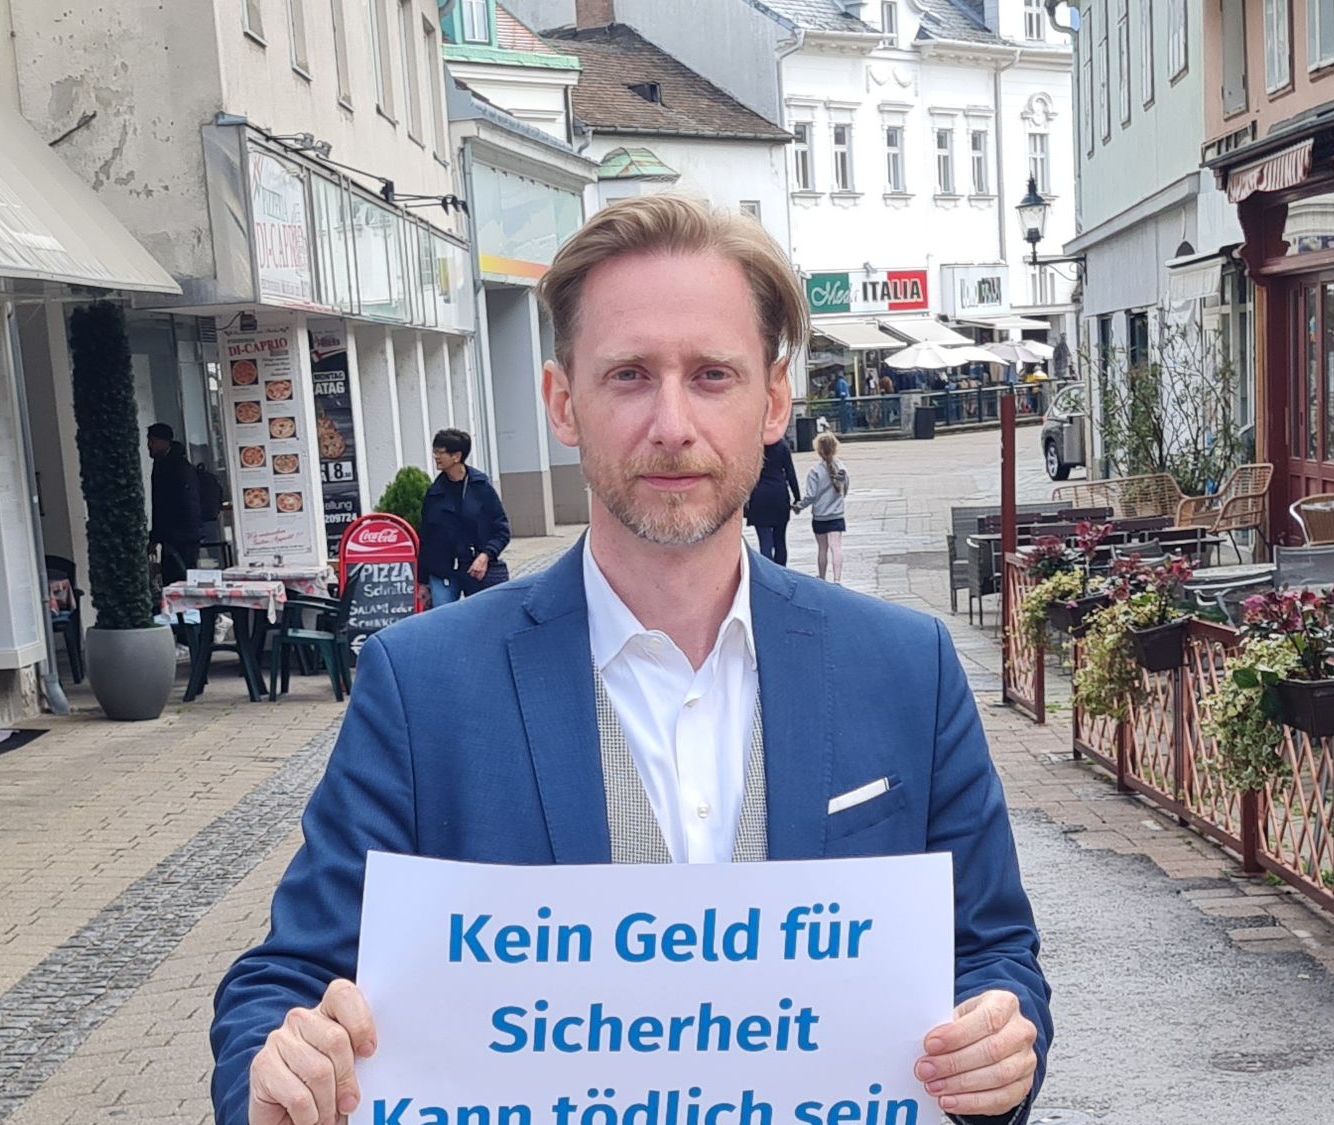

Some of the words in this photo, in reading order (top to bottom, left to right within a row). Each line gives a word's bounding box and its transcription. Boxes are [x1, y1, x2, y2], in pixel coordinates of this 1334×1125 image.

[862, 279, 923, 302] ITALIA
[228, 337, 288, 357] DI-CAPRIO
[360, 562, 414, 582] PIZZA
[448, 906, 593, 965] Kein
[614, 907, 762, 964] Geld
[779, 901, 874, 961] für
[490, 997, 820, 1055] Sicherheit
